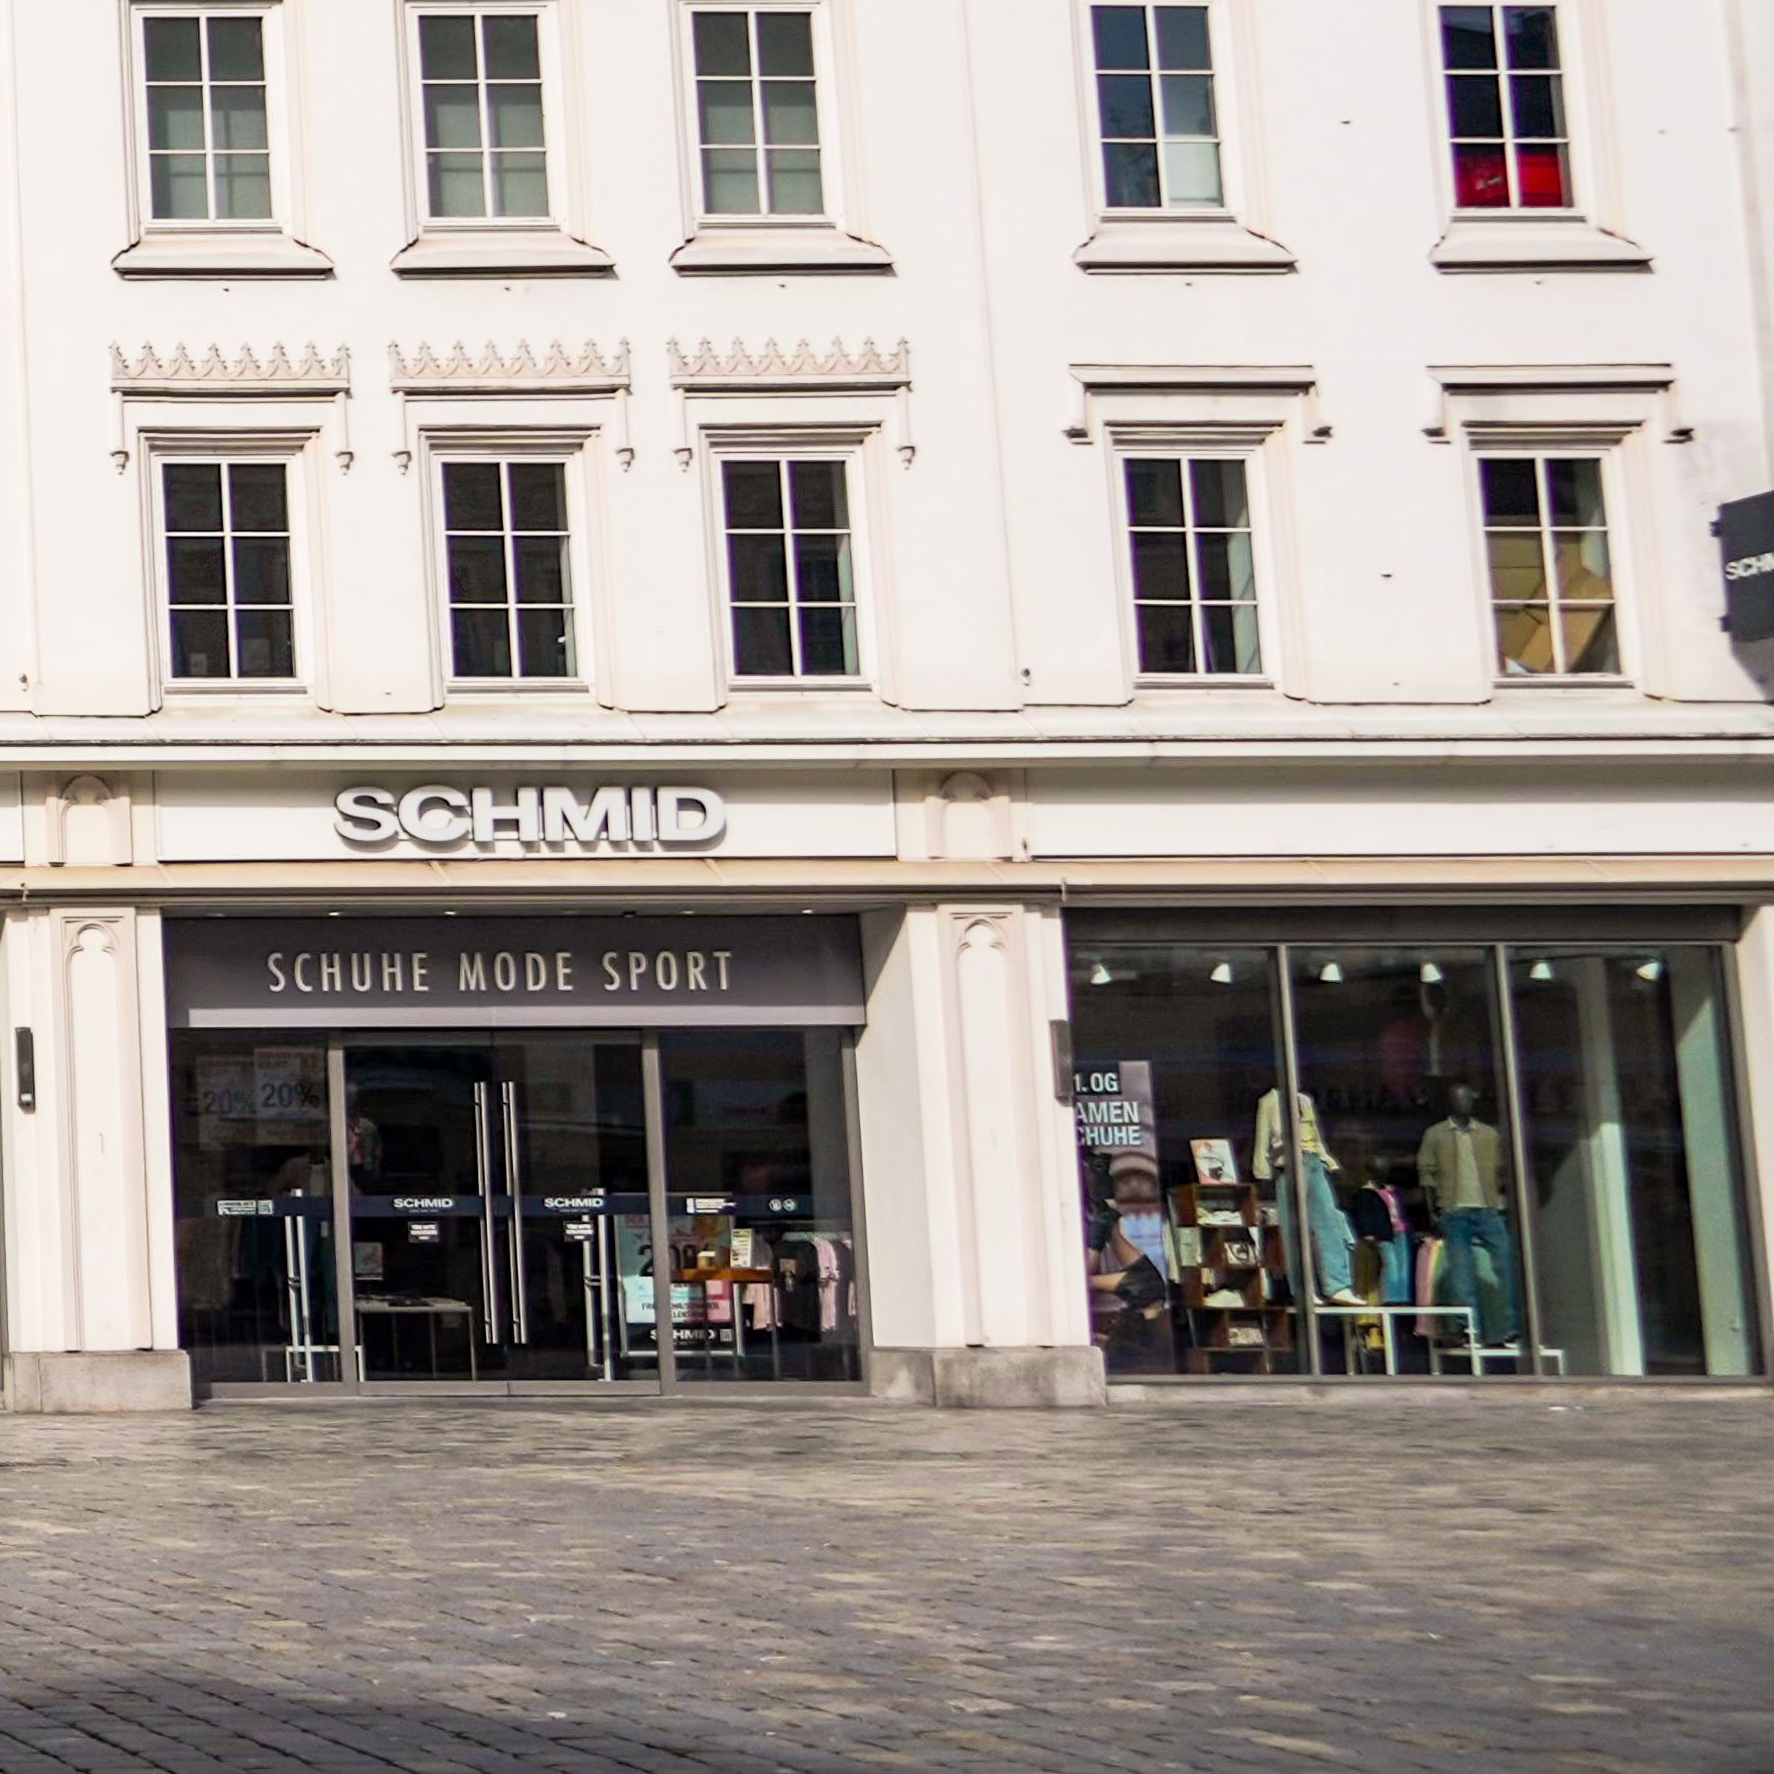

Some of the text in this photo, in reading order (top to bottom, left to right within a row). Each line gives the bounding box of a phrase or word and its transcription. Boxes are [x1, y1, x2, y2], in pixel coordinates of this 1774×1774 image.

[333, 784, 728, 847] SCHMID
[266, 950, 733, 993] SCHUHE MODE SPORT
[1076, 1101, 1140, 1123] AMEN
[393, 1198, 454, 1208] SCHMID
[544, 1197, 604, 1208] SCHMID
